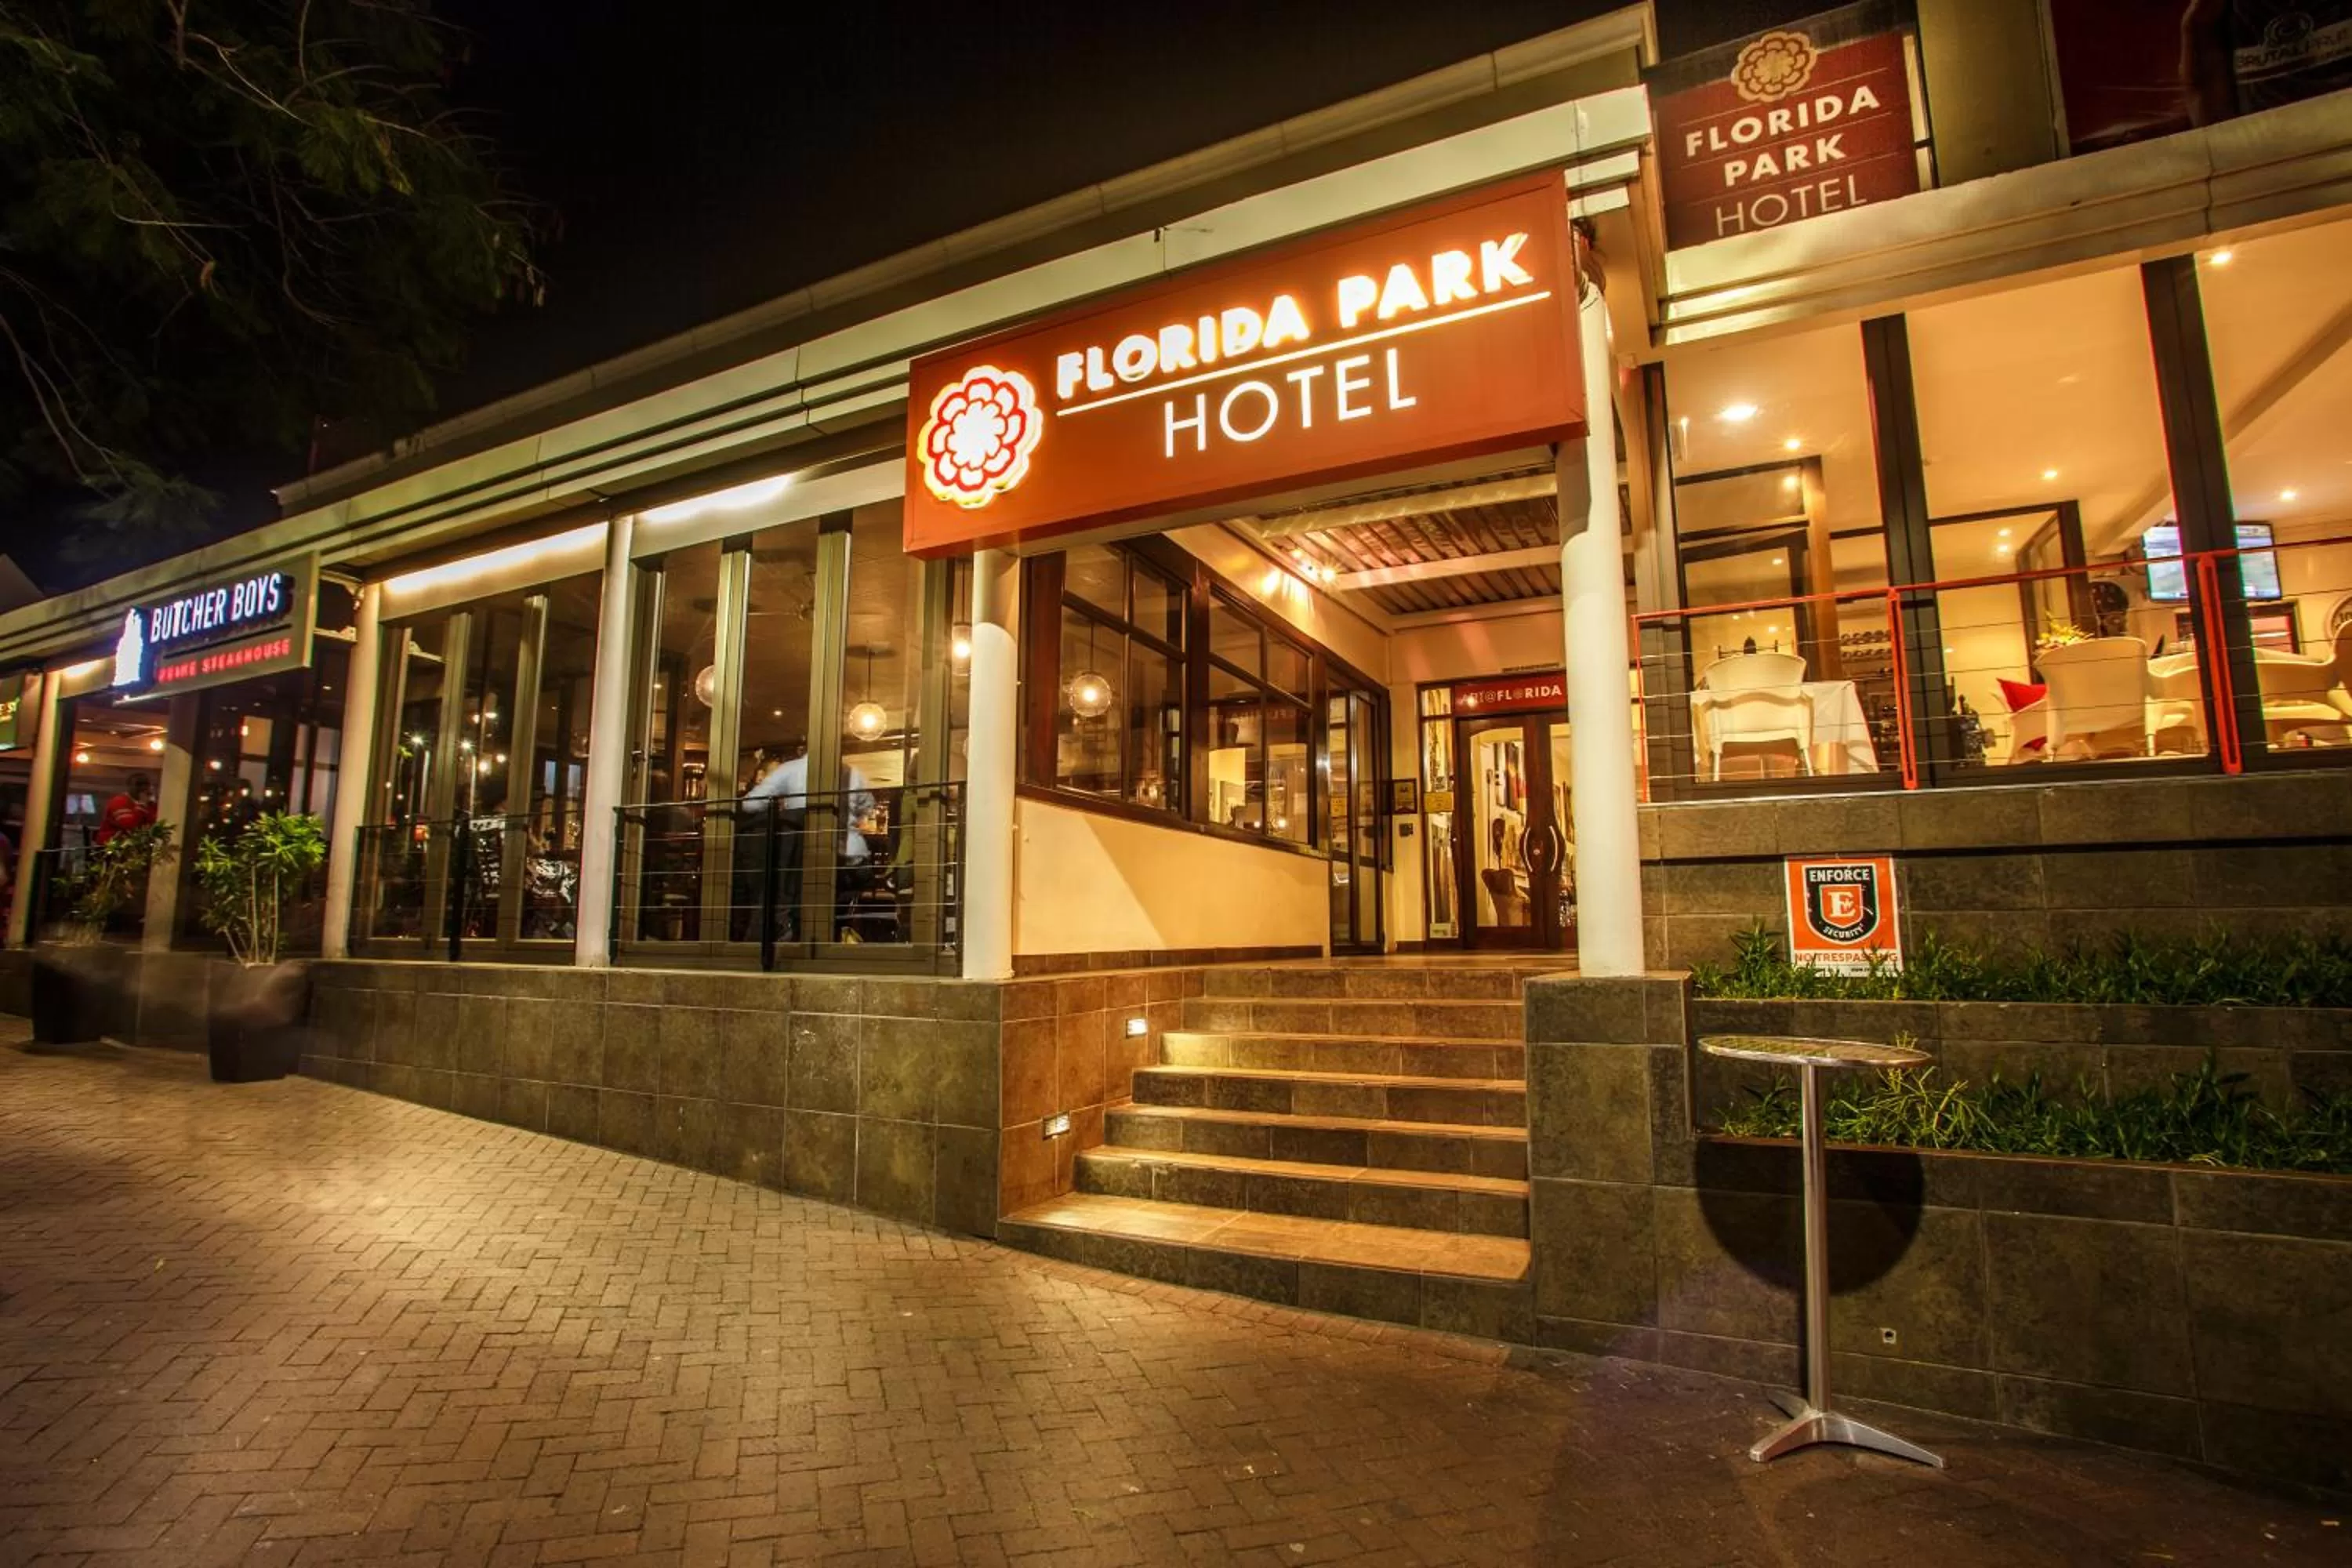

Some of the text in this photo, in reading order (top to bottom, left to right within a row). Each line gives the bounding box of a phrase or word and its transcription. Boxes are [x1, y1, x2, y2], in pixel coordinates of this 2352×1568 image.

[1686, 85, 1881, 157] FLORIDA
[1724, 132, 1846, 187] PARK
[1715, 174, 1867, 236] HOTEL
[1055, 232, 1534, 400] FLORIDA PARK
[1164, 347, 1418, 458] HOTEL
[150, 572, 281, 644] BUTCHER BOYS
[201, 638, 291, 673] STEAKHOUSE
[1809, 869, 1871, 882] ENFORCE
[1795, 952, 1898, 963] NO TRESPASSG
[1823, 923, 1864, 938] SECURITY
